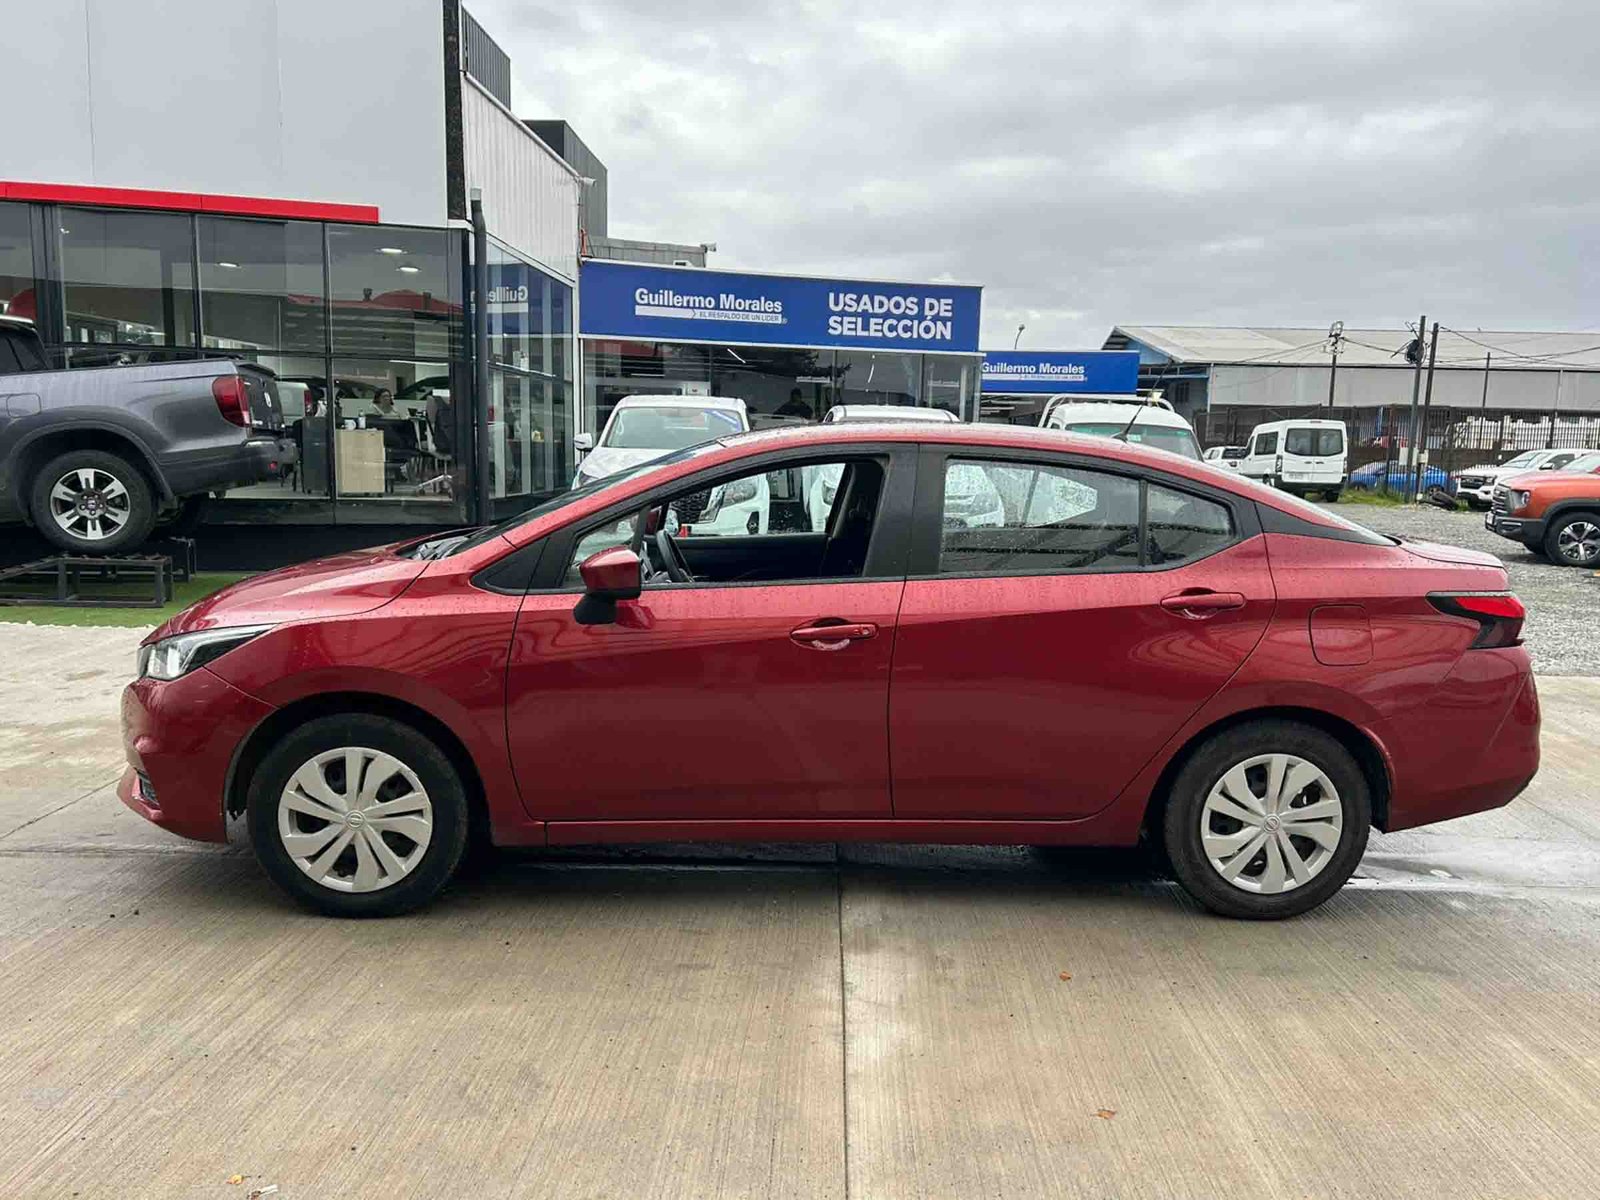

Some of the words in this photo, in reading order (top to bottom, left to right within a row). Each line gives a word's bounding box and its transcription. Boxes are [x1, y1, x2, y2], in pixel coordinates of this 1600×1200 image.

[635, 287, 715, 309] Guillermo
[719, 293, 783, 312] Morales
[829, 292, 919, 316] USADOS
[924, 297, 953, 317] DE
[708, 311, 741, 320] RESPALDO
[828, 315, 952, 340] SELECCIÓN
[982, 362, 1036, 373] Guillermo
[1039, 363, 1085, 374] Morales
